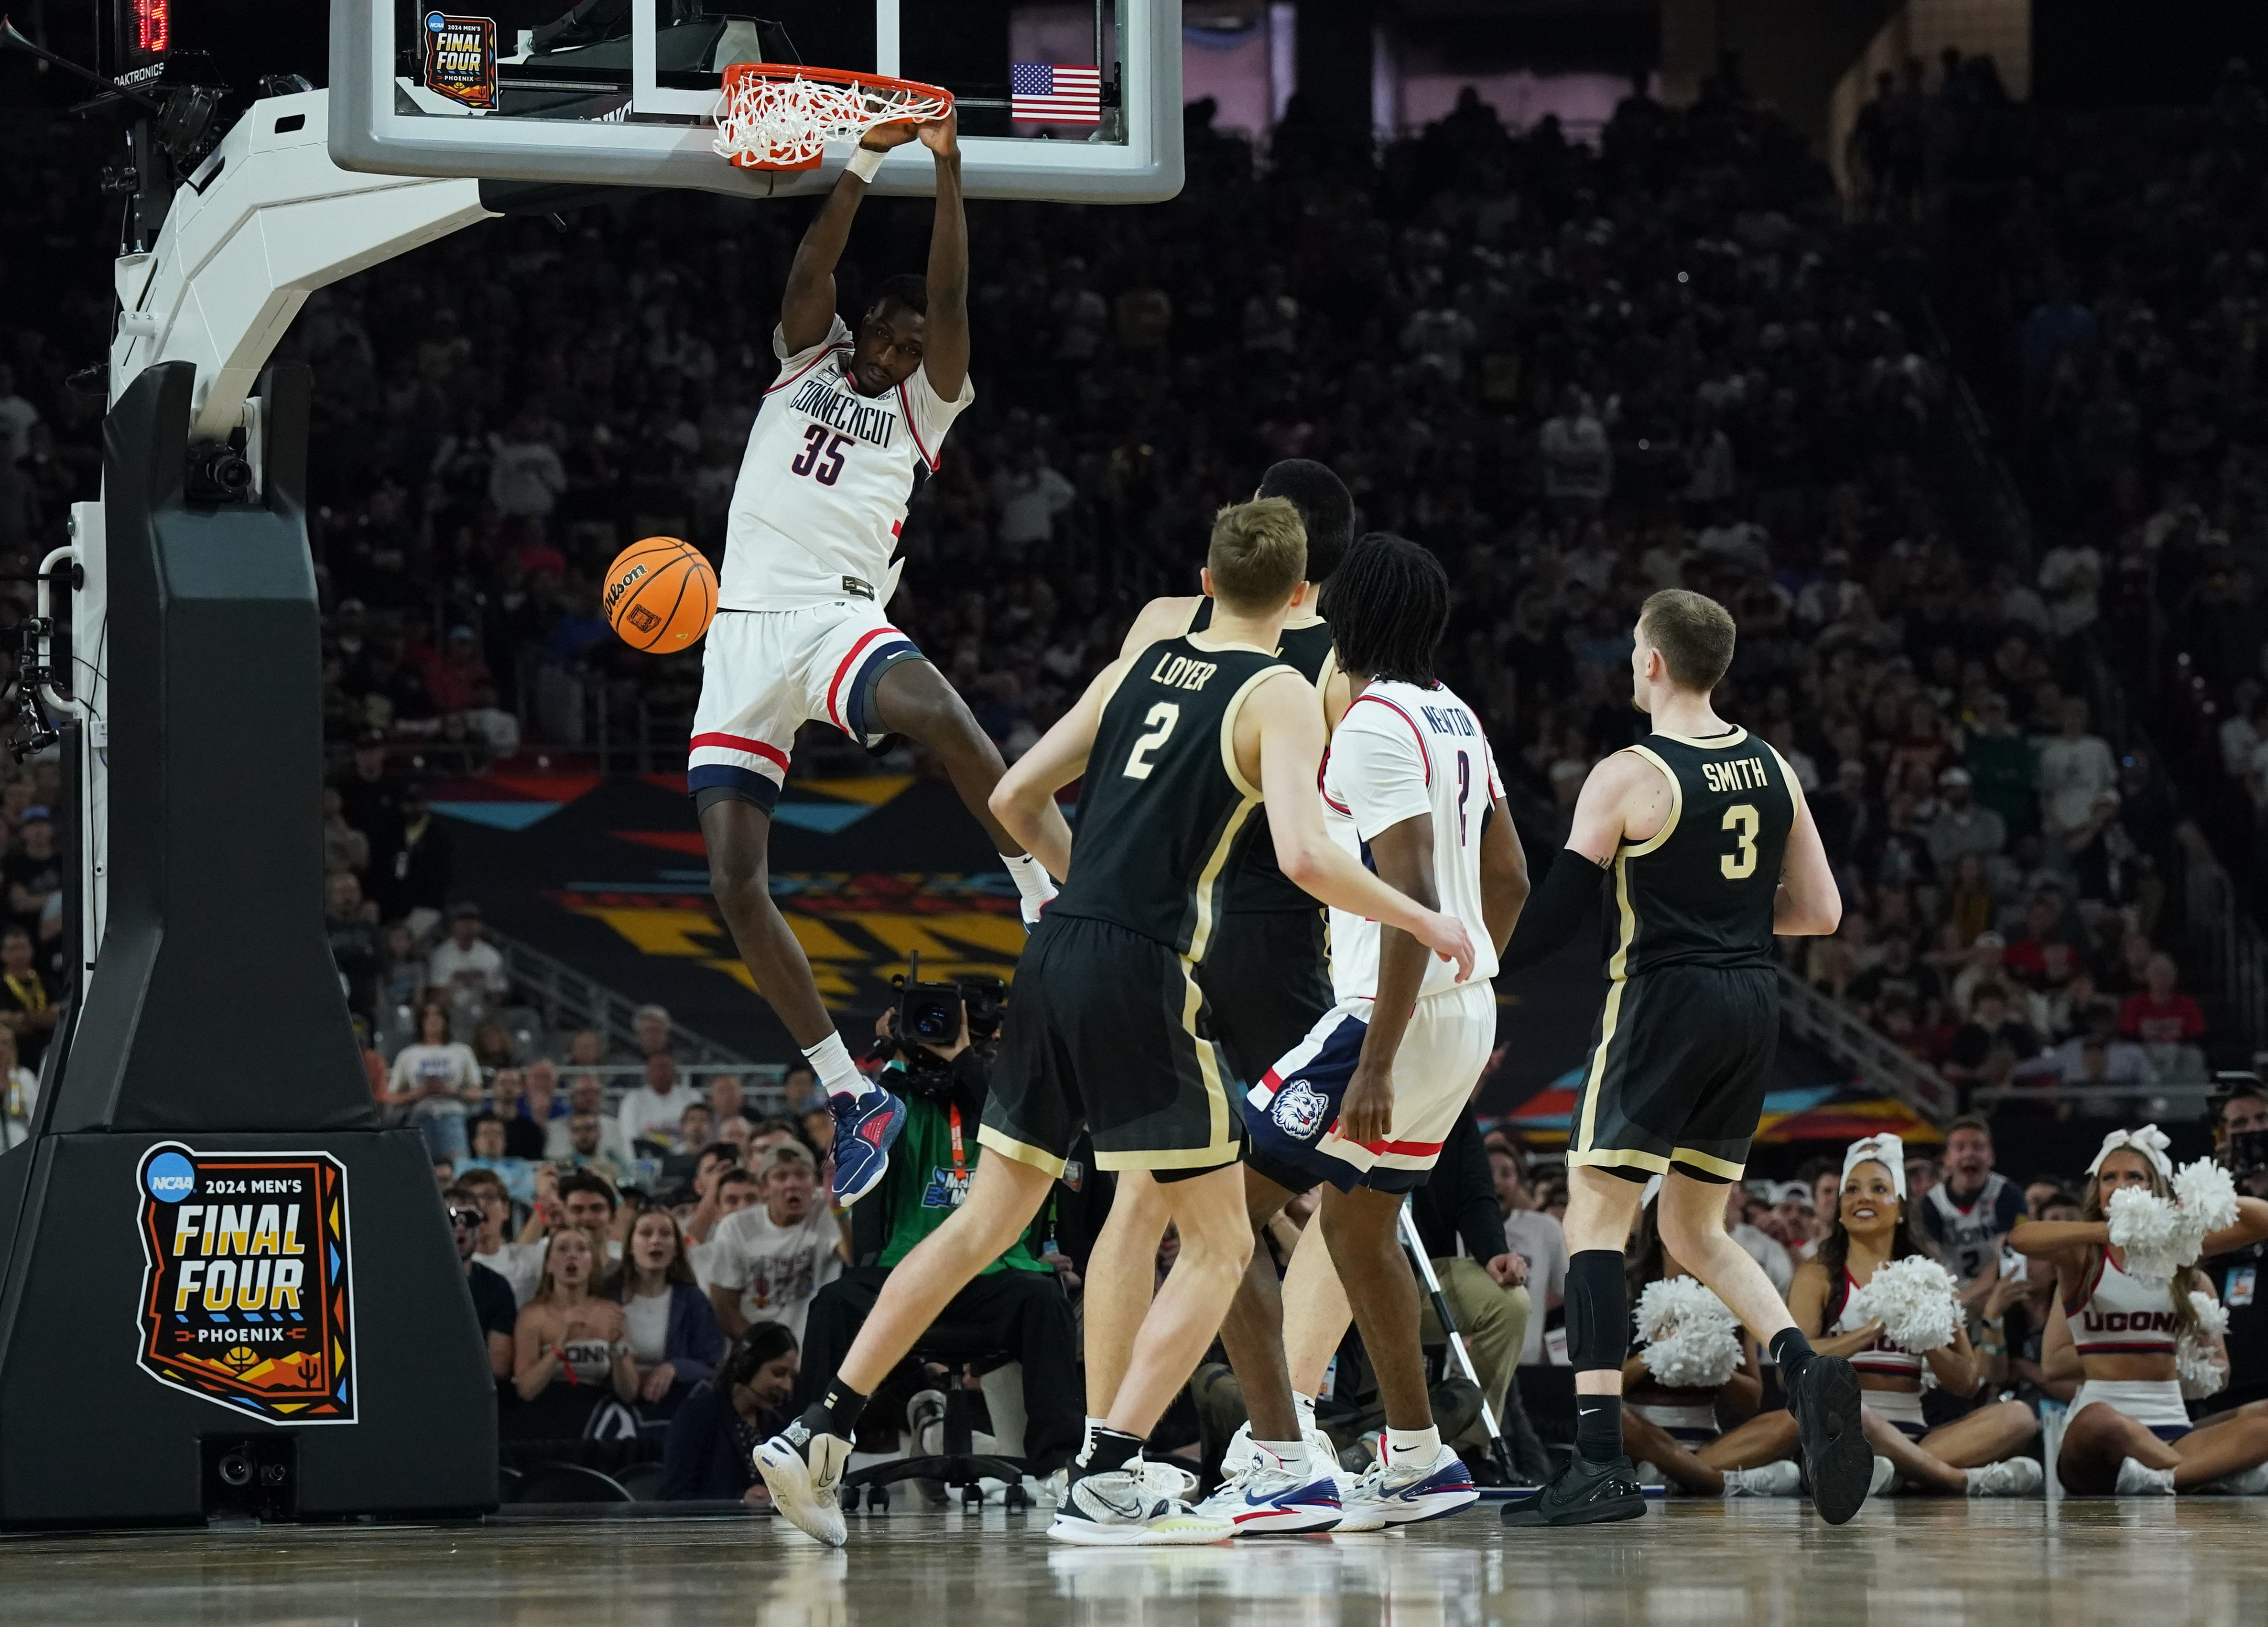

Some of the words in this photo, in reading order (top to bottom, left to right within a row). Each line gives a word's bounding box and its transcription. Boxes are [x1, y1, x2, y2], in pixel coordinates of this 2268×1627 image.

[436, 33, 481, 53] FINAL
[436, 52, 481, 71] FOUR
[114, 62, 164, 86] DAKTRONICS
[790, 380, 897, 448] CONNECTICUT
[792, 424, 856, 486] 35
[1150, 652, 1217, 691] LOYER
[1122, 701, 1180, 780] 2
[1421, 706, 1478, 738] NEWTON
[1702, 757, 1768, 792] SMITH
[1457, 750, 1470, 846] 2
[1720, 803, 1760, 880] 3
[152, 1176, 194, 1191] NCAA
[206, 1180, 247, 1194] 2024
[251, 1179, 302, 1193] MEN'S
[173, 1204, 305, 1256] FINAL
[174, 1258, 304, 1312] FOUR
[198, 1328, 284, 1343] PHOENIX
